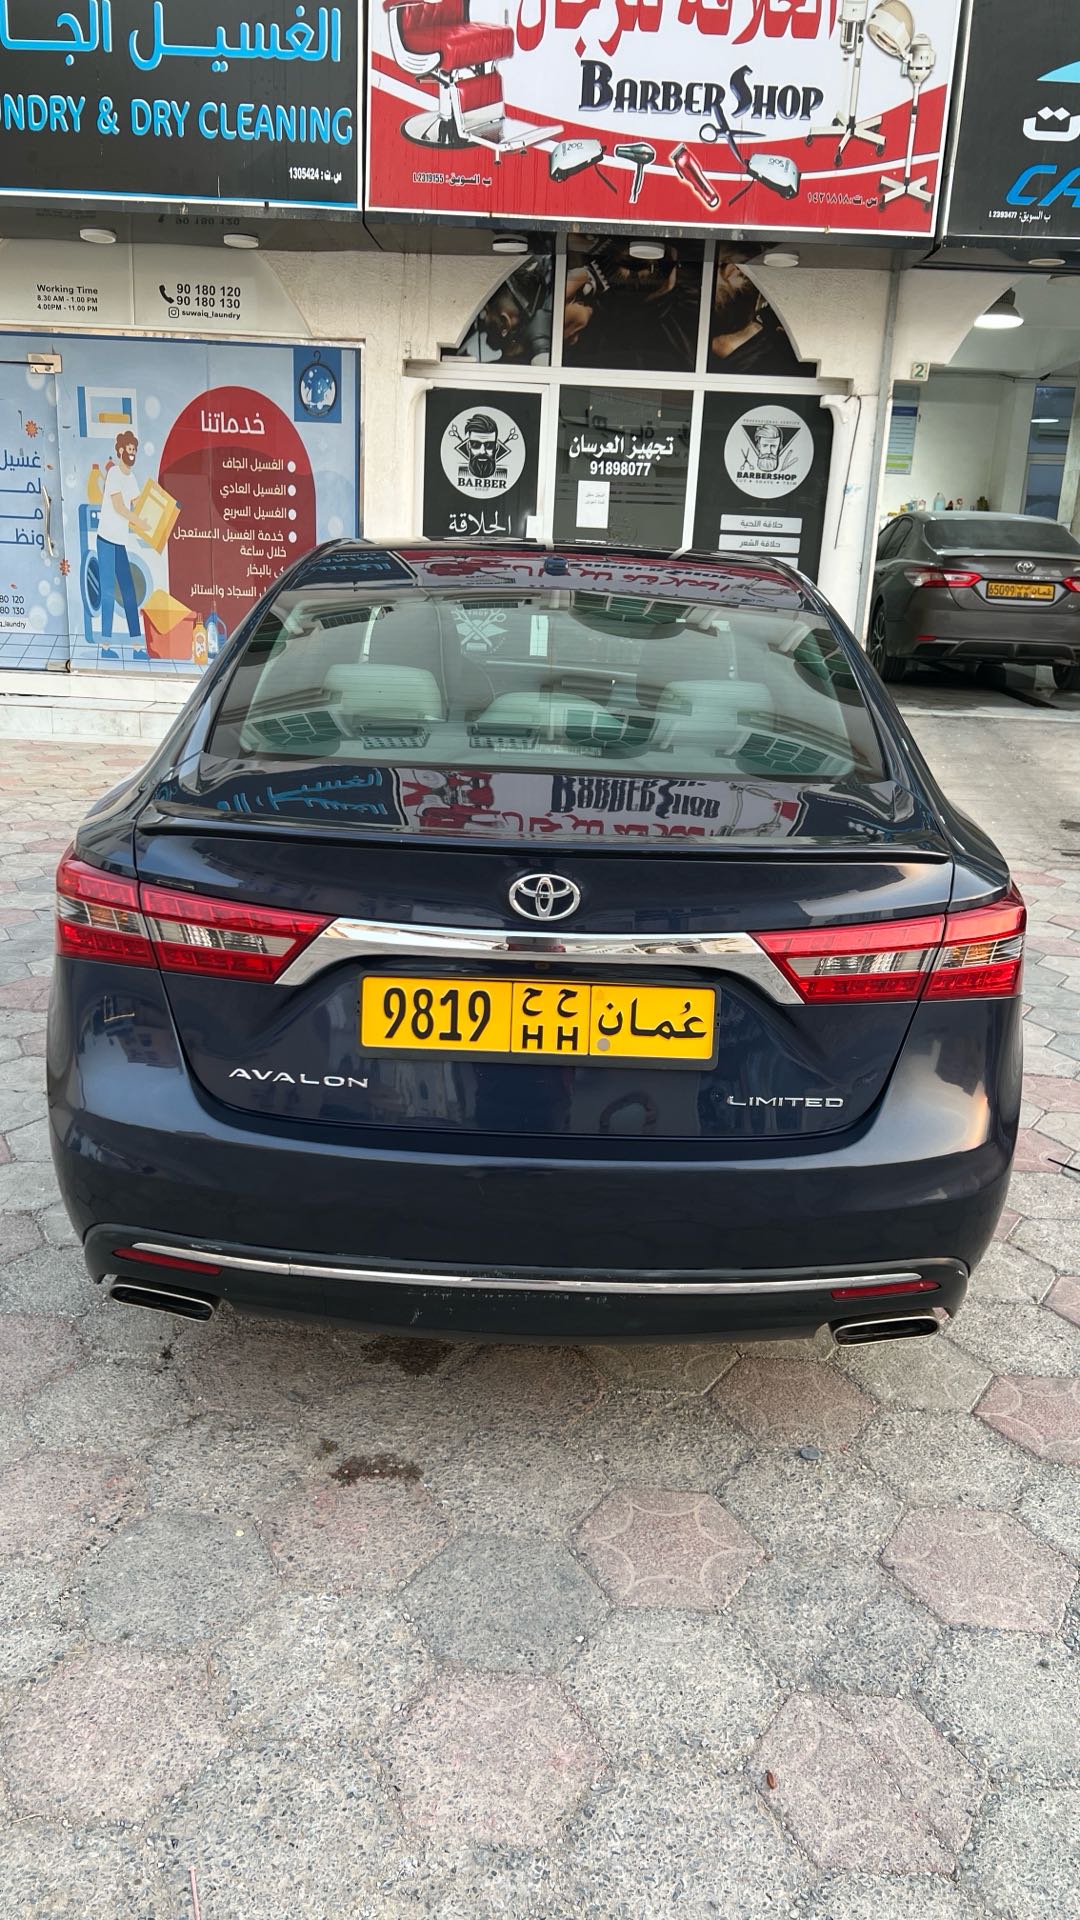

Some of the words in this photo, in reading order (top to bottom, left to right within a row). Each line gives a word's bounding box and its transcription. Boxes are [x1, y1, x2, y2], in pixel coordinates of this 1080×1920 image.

[129, 0, 341, 71] الغسيل
[729, 64, 824, 121] SHOP
[0, 93, 86, 134] NDRY
[97, 95, 120, 136] &
[130, 98, 191, 138] DRY
[199, 101, 354, 145] CLEANING
[288, 166, 320, 181] 1305424
[1005, 163, 1080, 208] CA
[36, 283, 74, 295] Working
[76, 286, 98, 295] Time
[176, 283, 191, 294] 90
[194, 284, 216, 296] 180
[219, 285, 241, 297] 120
[53, 295, 65, 303] AM
[176, 295, 191, 306] 90
[194, 296, 216, 308] 180
[219, 297, 241, 309] 130
[181, 309, 241, 320] suwaiq_laundry
[914, 363, 924, 378] 2
[200, 409, 265, 435] خدماتنا
[568, 433, 625, 459] العرسان
[626, 435, 675, 461] تجهيز
[222, 457, 248, 472] الجاف
[250, 459, 284, 472] الغسيل
[590, 460, 652, 477] 91898077
[457, 477, 507, 489] BARBER
[736, 471, 797, 481] BARBERSHOP
[219, 482, 250, 499] العادي
[252, 484, 287, 497] الغسيل
[223, 505, 251, 521] السريع
[253, 507, 287, 520] الغسيل
[448, 509, 512, 536] الحلاقة
[222, 529, 255, 542] الغسيل
[257, 530, 284, 542] خدمة
[240, 544, 264, 557] ساعة
[266, 545, 287, 558] خلال
[246, 563, 271, 578] بالبخار
[190, 584, 225, 599] والستائر
[226, 585, 257, 599] السجاد
[12, 595, 25, 604] 120
[12, 606, 25, 615] 130
[521, 986, 545, 1017] ح
[556, 988, 579, 1018] ح
[381, 986, 493, 1042] 9819
[521, 1024, 544, 1051] H
[556, 1025, 579, 1052] H
[228, 1066, 369, 1089] AVALON
[726, 1094, 845, 1110] LIMITED
